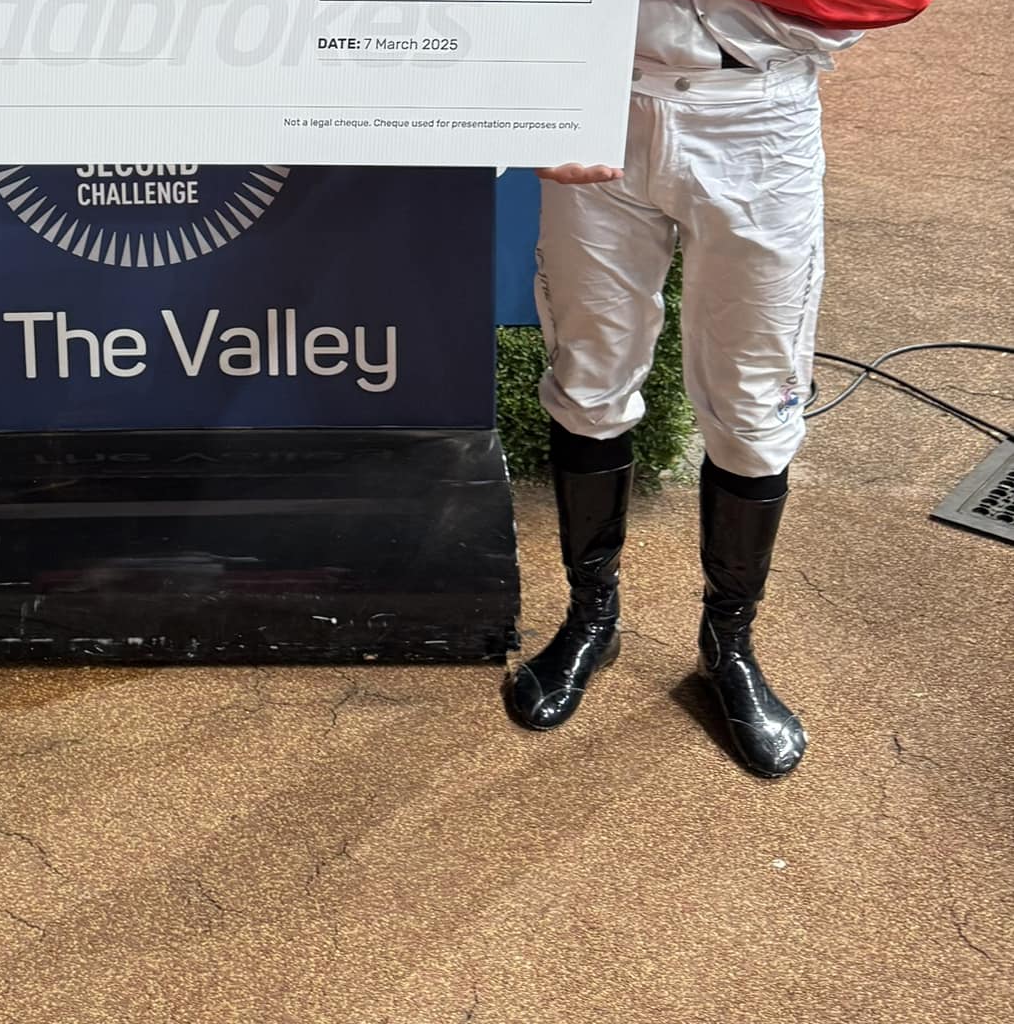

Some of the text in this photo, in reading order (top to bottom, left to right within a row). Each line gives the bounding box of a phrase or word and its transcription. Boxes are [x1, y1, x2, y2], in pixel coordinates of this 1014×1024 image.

[317, 37, 459, 50] DATE: 7 March 2025
[284, 118, 300, 127] Not
[310, 118, 332, 129] legal
[334, 118, 372, 129] cheque.
[373, 118, 409, 129] Cheque
[411, 119, 434, 128] used
[436, 119, 450, 128] for
[451, 119, 511, 130] presentation
[512, 121, 556, 131] purposes
[558, 121, 582, 131] only.
[77, 181, 199, 206] CHALLENGE
[3, 308, 397, 393] The Valley
